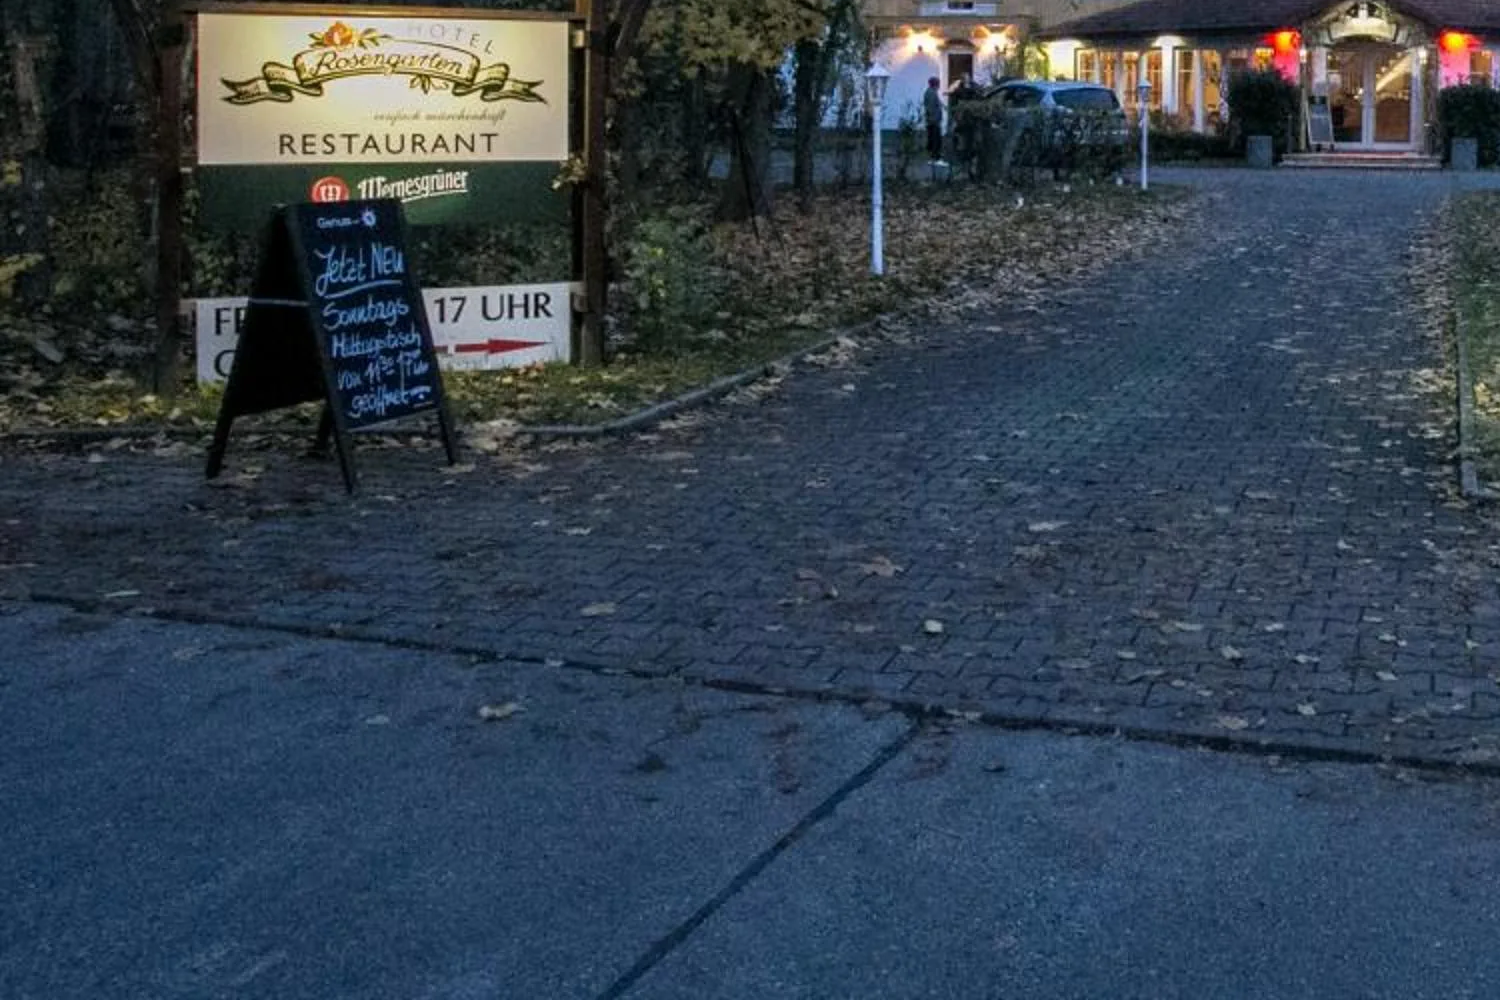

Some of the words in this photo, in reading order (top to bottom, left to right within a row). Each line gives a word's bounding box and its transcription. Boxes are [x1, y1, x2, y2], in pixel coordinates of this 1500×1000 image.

[408, 23, 493, 55] HOTEL
[310, 48, 463, 77] Rosengarten
[278, 133, 499, 155] RESTAURANT
[357, 169, 469, 200] Wernesgrüner
[313, 246, 367, 297] Jetzt
[434, 296, 466, 324] 17
[481, 291, 553, 322] UHR
